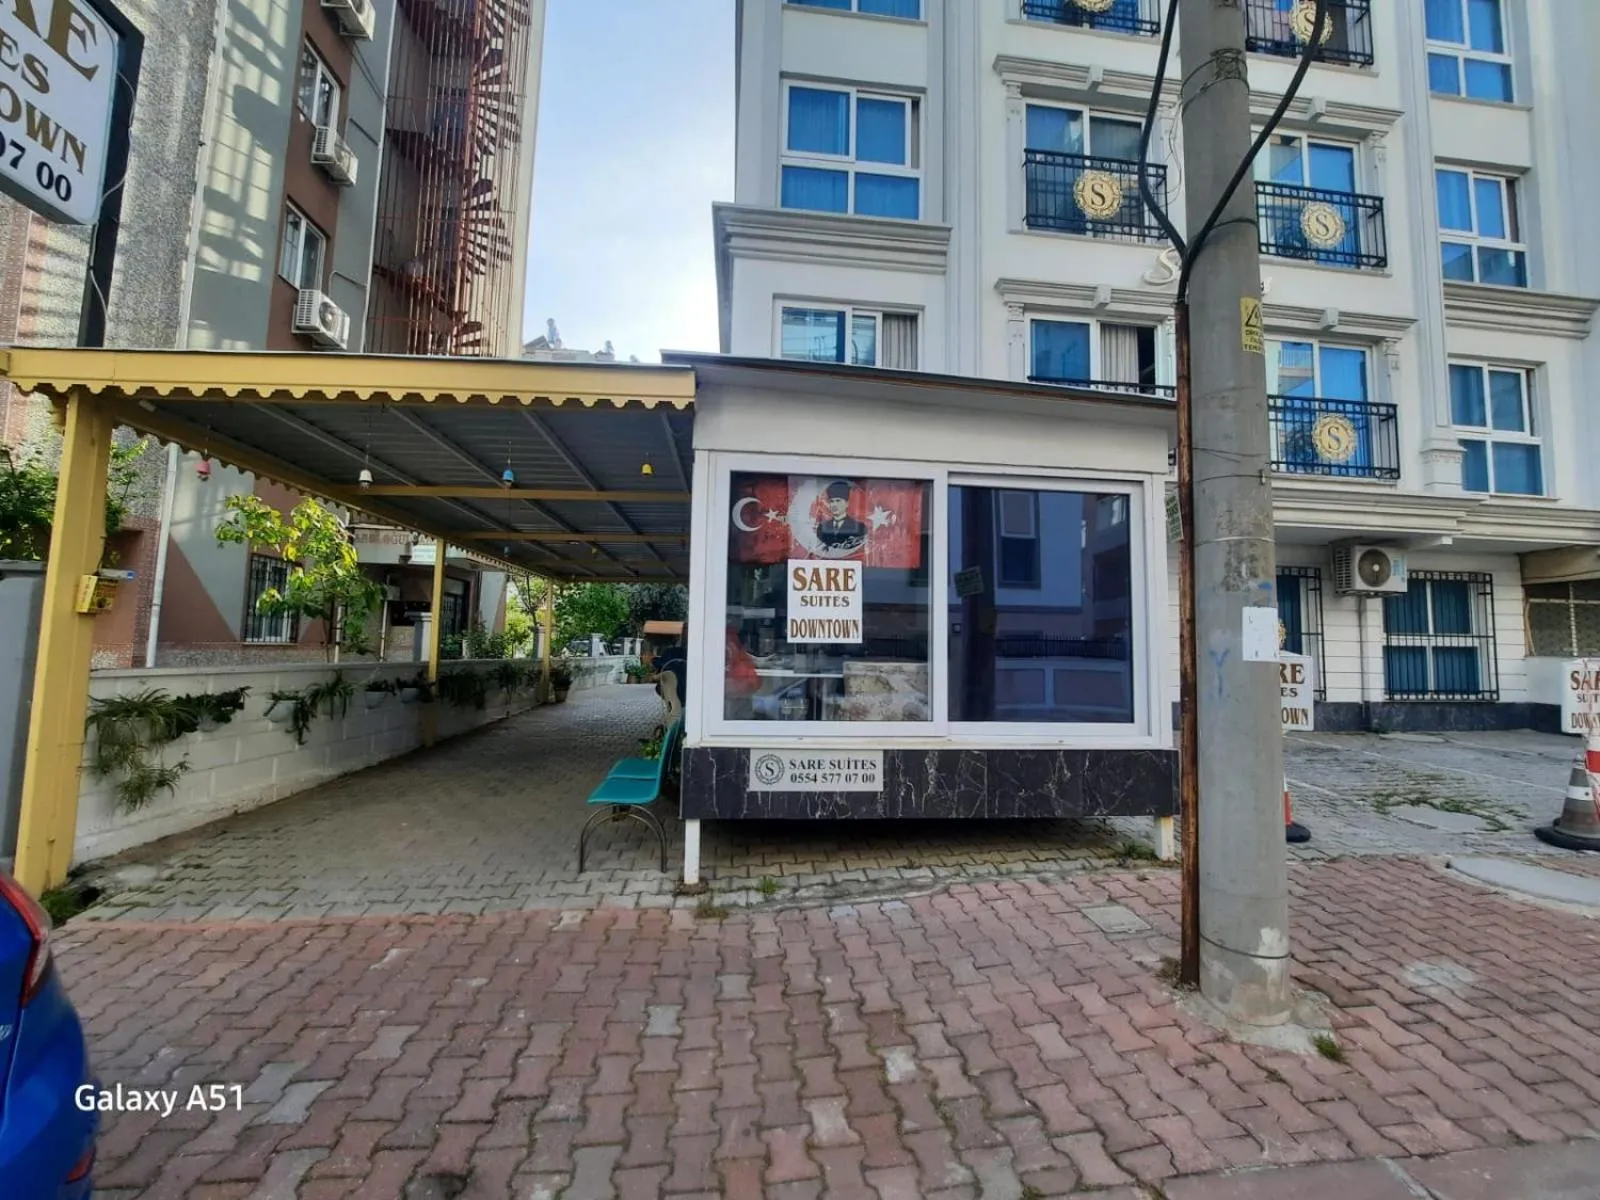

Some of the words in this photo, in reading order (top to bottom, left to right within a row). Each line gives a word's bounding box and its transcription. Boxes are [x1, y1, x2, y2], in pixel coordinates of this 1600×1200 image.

[0, 82, 87, 175] OWN
[36, 161, 72, 202] 00
[792, 567, 856, 592] SARE
[800, 595, 850, 607] SUITES
[790, 618, 859, 639] DOWNTOWN
[1281, 707, 1308, 725] OWN
[789, 759, 826, 770] SARE
[790, 773, 817, 784] 0554
[821, 773, 841, 784] 577
[845, 773, 859, 784] 07
[861, 773, 875, 784] 00
